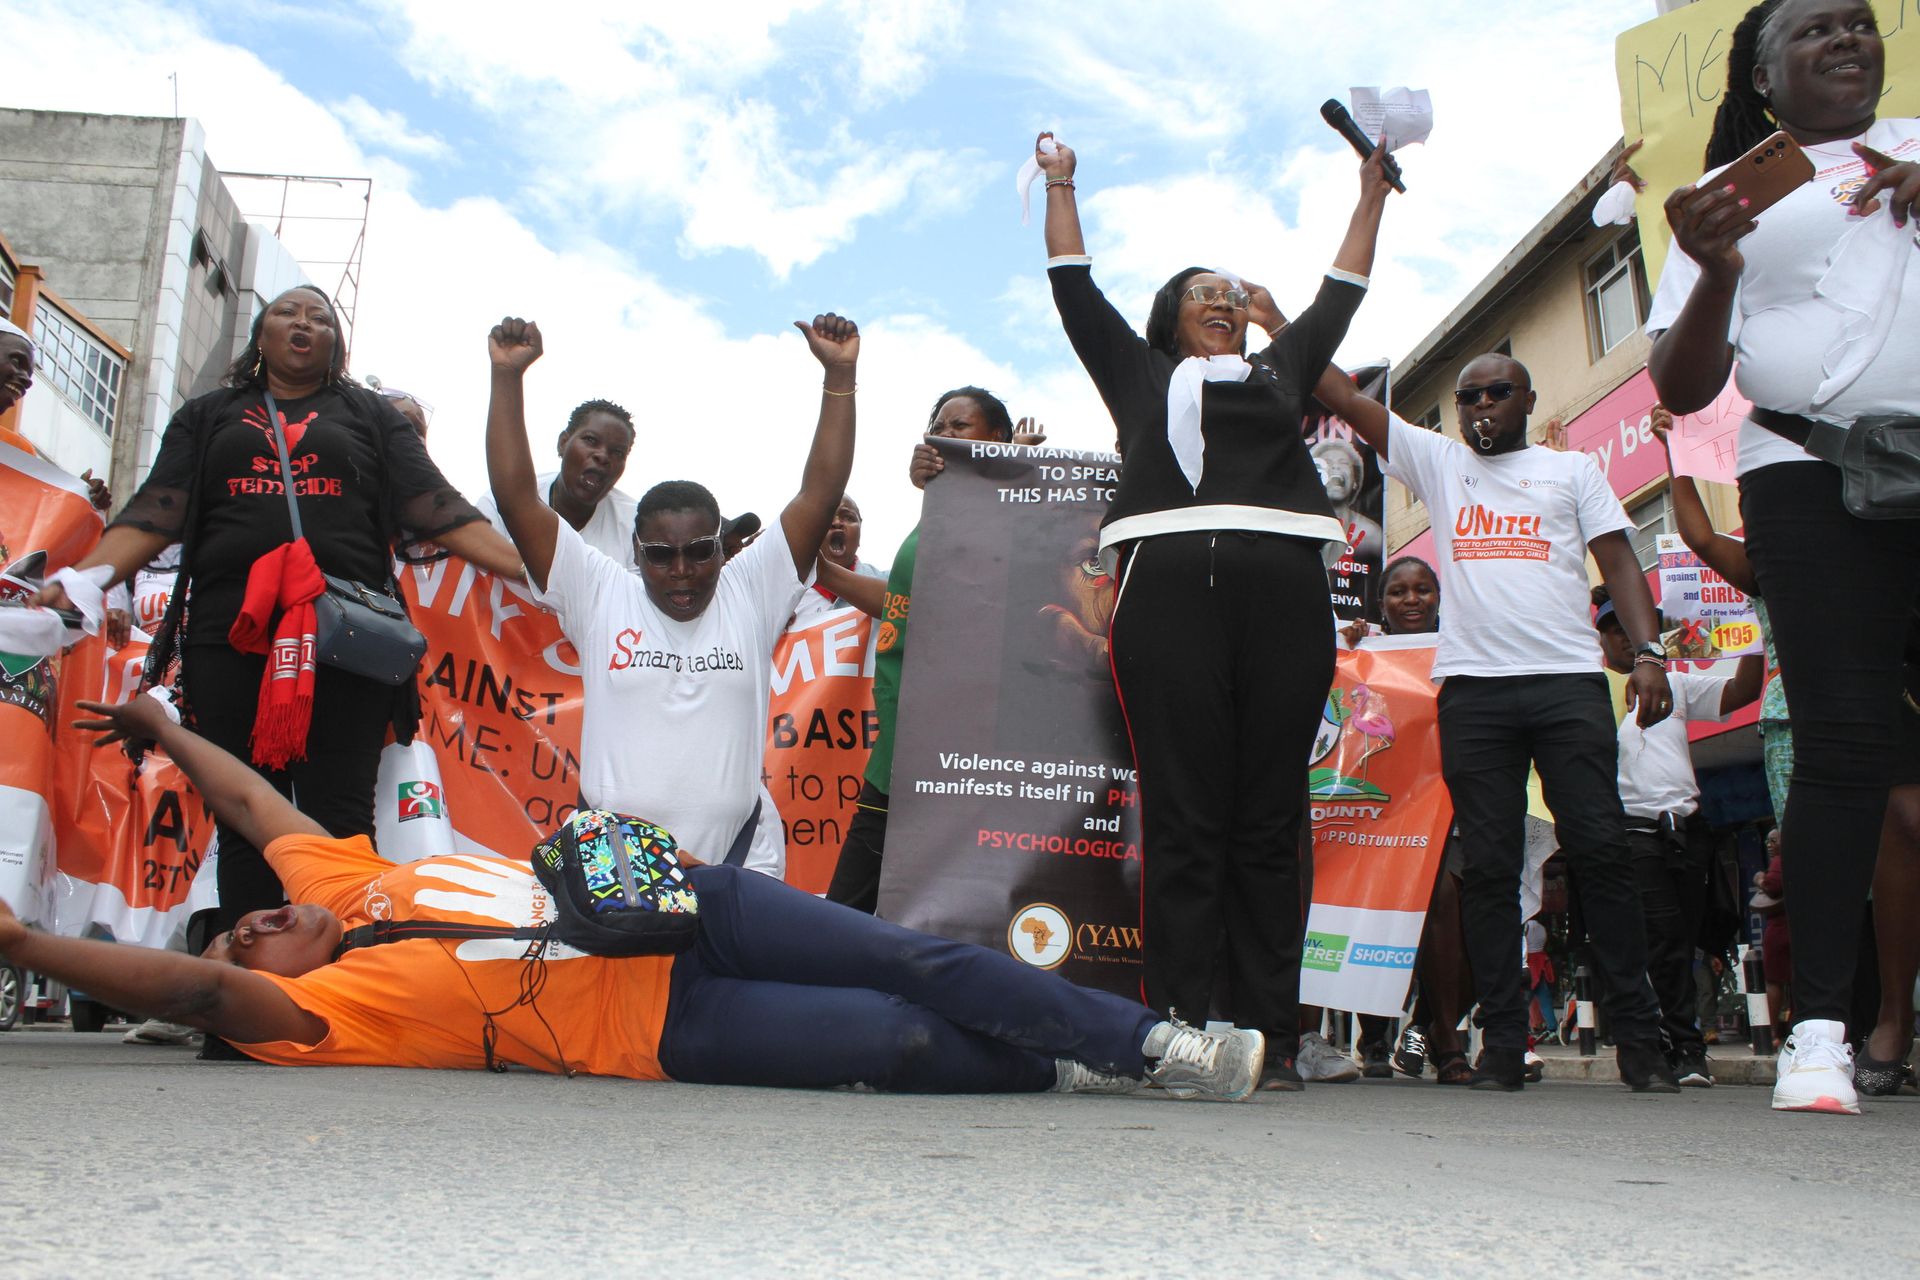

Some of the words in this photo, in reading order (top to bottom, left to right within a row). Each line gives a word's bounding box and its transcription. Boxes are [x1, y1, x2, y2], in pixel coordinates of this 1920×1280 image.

[971, 443, 1020, 459] HOW
[1026, 447, 1086, 460] MANY
[251, 453, 318, 476] STOP
[1039, 465, 1066, 481] TO
[1071, 466, 1119, 482] SPEA
[226, 477, 342, 496] FEMCIDE
[998, 488, 1041, 503] THIS
[1047, 487, 1087, 502] HAS
[1455, 504, 1541, 537] UNITE!
[1455, 551, 1475, 559] AINST
[1476, 550, 1506, 558] WOMEN
[1526, 551, 1547, 559] GIRLS
[1482, 540, 1511, 548] PREVENT
[1513, 540, 1549, 551] VIOLENCE
[1337, 577, 1350, 588] IN
[1666, 572, 1697, 582] against
[1700, 569, 1729, 584] WO
[1331, 593, 1362, 607] ENYA
[1683, 591, 1699, 601] and
[1701, 586, 1745, 604] GIRLS
[1700, 608, 1712, 617] Call
[1713, 609, 1727, 617] Free
[1715, 624, 1753, 648] 1195
[608, 627, 684, 673] Smart
[687, 645, 744, 674] ladies
[420, 651, 564, 725] AINST
[429, 706, 513, 777] ME:
[785, 765, 824, 801] to
[939, 752, 1026, 773] Violence
[1031, 759, 1106, 779] against
[915, 778, 1013, 797] manifests
[1019, 781, 1071, 802] itself
[1076, 785, 1096, 804] in
[1083, 815, 1121, 833] and
[1320, 830, 1429, 848] OPPORTUNITIES
[529, 894, 547, 956] OANGE
[1304, 946, 1346, 963] FREE
[1353, 947, 1415, 965] SHOFCO
